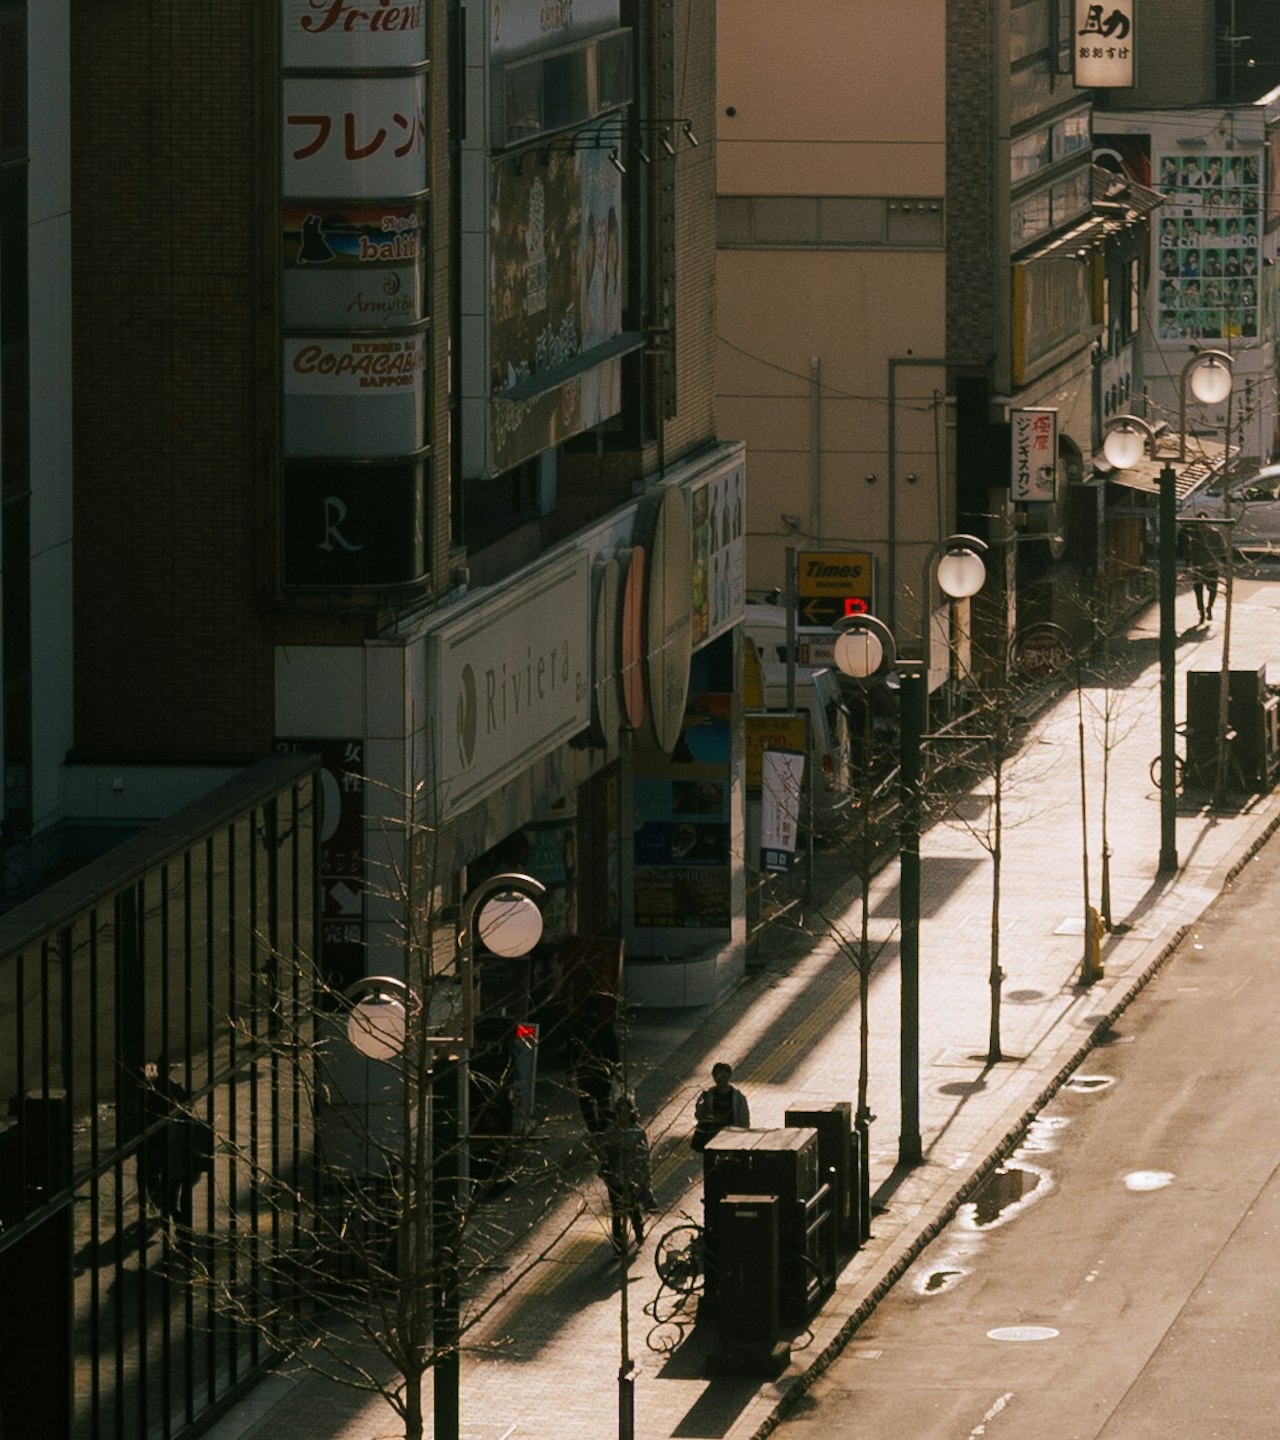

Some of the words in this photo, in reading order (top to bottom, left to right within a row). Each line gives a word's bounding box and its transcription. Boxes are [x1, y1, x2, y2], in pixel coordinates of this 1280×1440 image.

[1079, 47, 1130, 59] おおすけ
[1017, 418, 1030, 498] ジンギスカン
[806, 562, 862, 578] Times
[485, 639, 569, 734] Riviera
